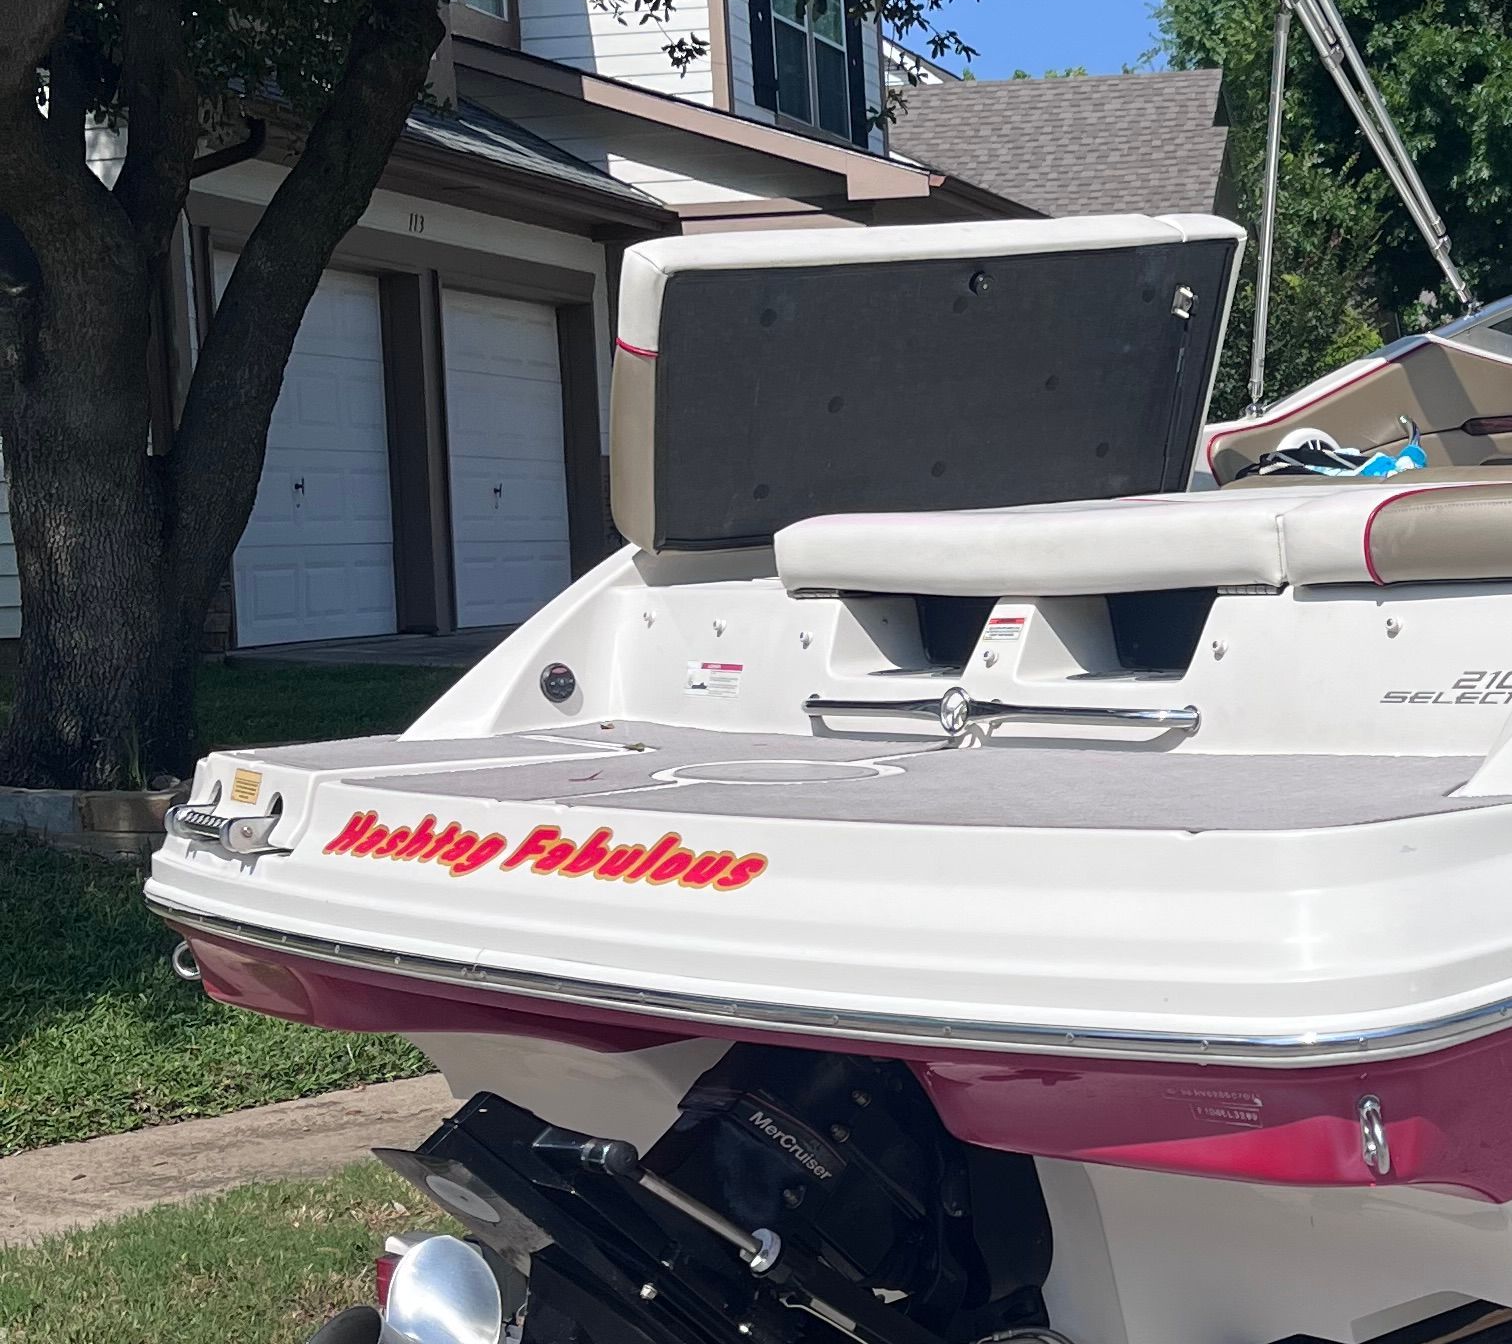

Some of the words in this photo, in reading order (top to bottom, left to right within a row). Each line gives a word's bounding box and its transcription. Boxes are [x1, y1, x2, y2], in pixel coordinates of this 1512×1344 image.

[408, 212, 425, 234] 113
[322, 810, 507, 877] Hashtag
[499, 824, 768, 892] Fabulous
[748, 1111, 833, 1180] MerCruiser
